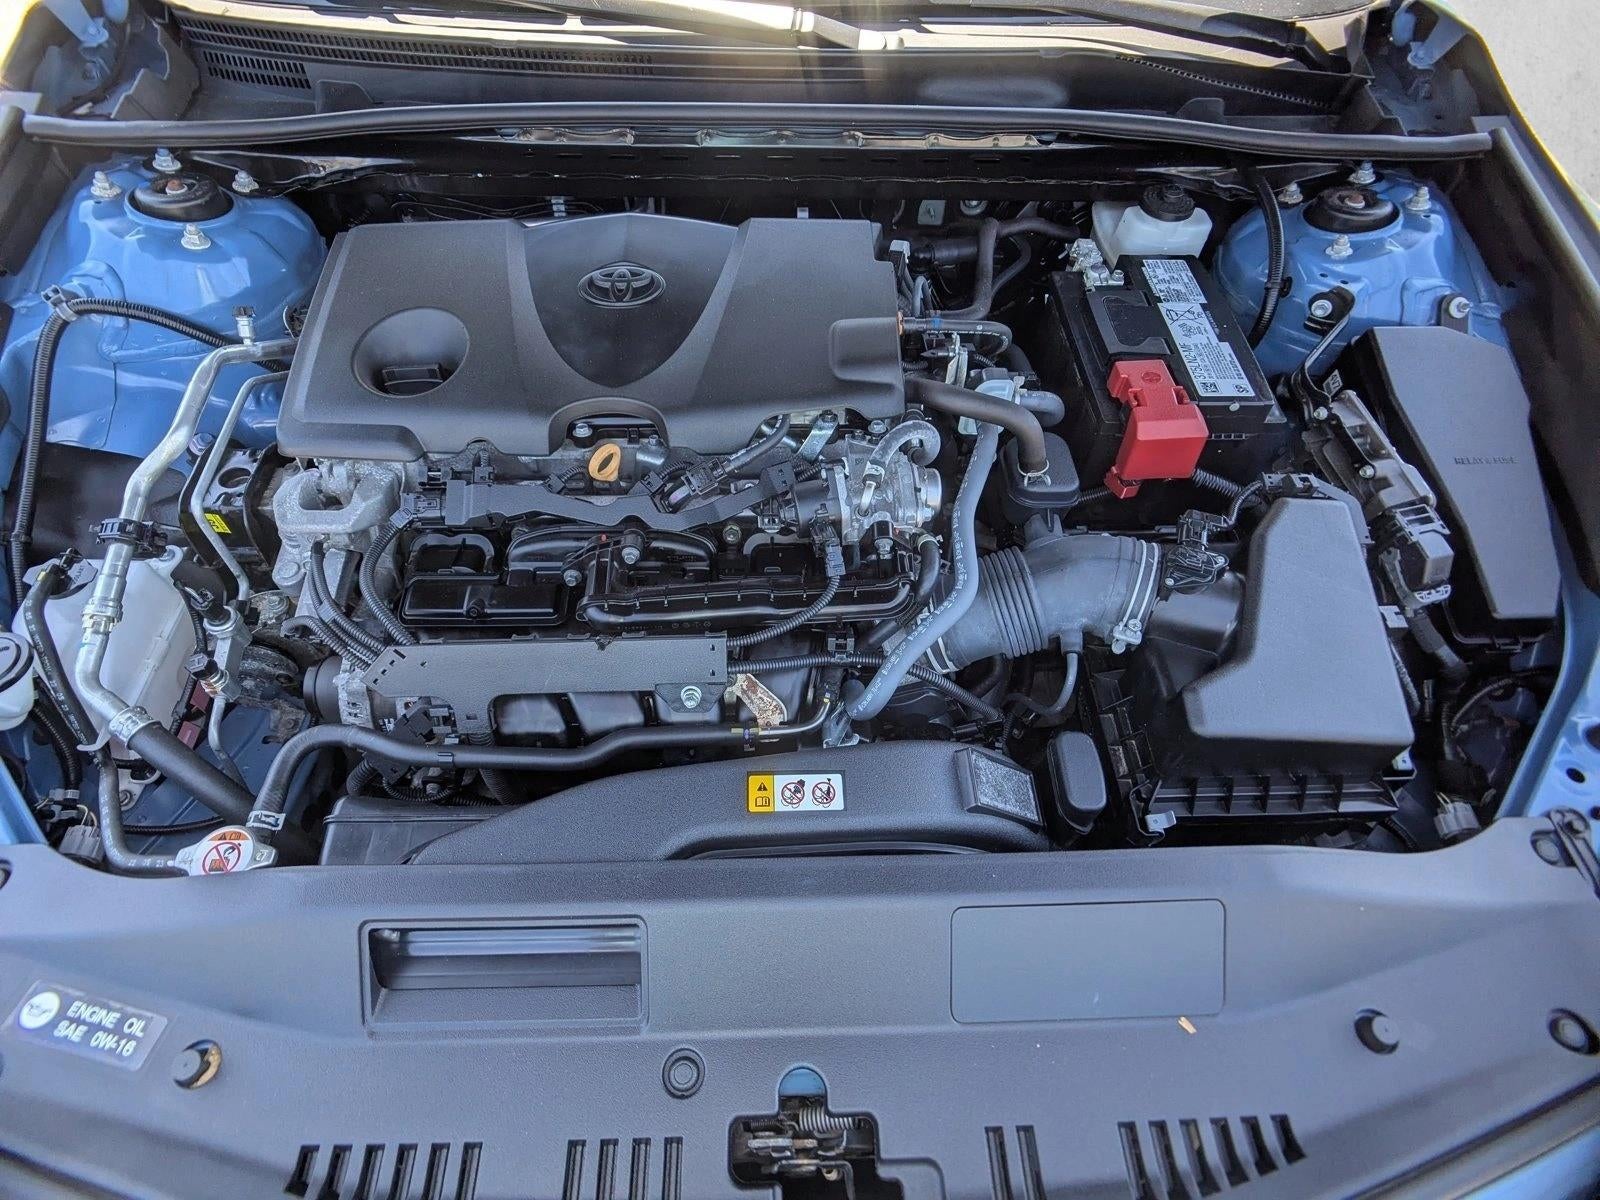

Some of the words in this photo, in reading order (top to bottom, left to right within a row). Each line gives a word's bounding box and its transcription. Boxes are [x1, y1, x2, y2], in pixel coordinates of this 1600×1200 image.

[66, 1000, 121, 1029] ENGINE
[123, 1017, 146, 1038] OIL
[53, 1020, 88, 1042] SAE
[90, 1031, 136, 1057] 0W-16
